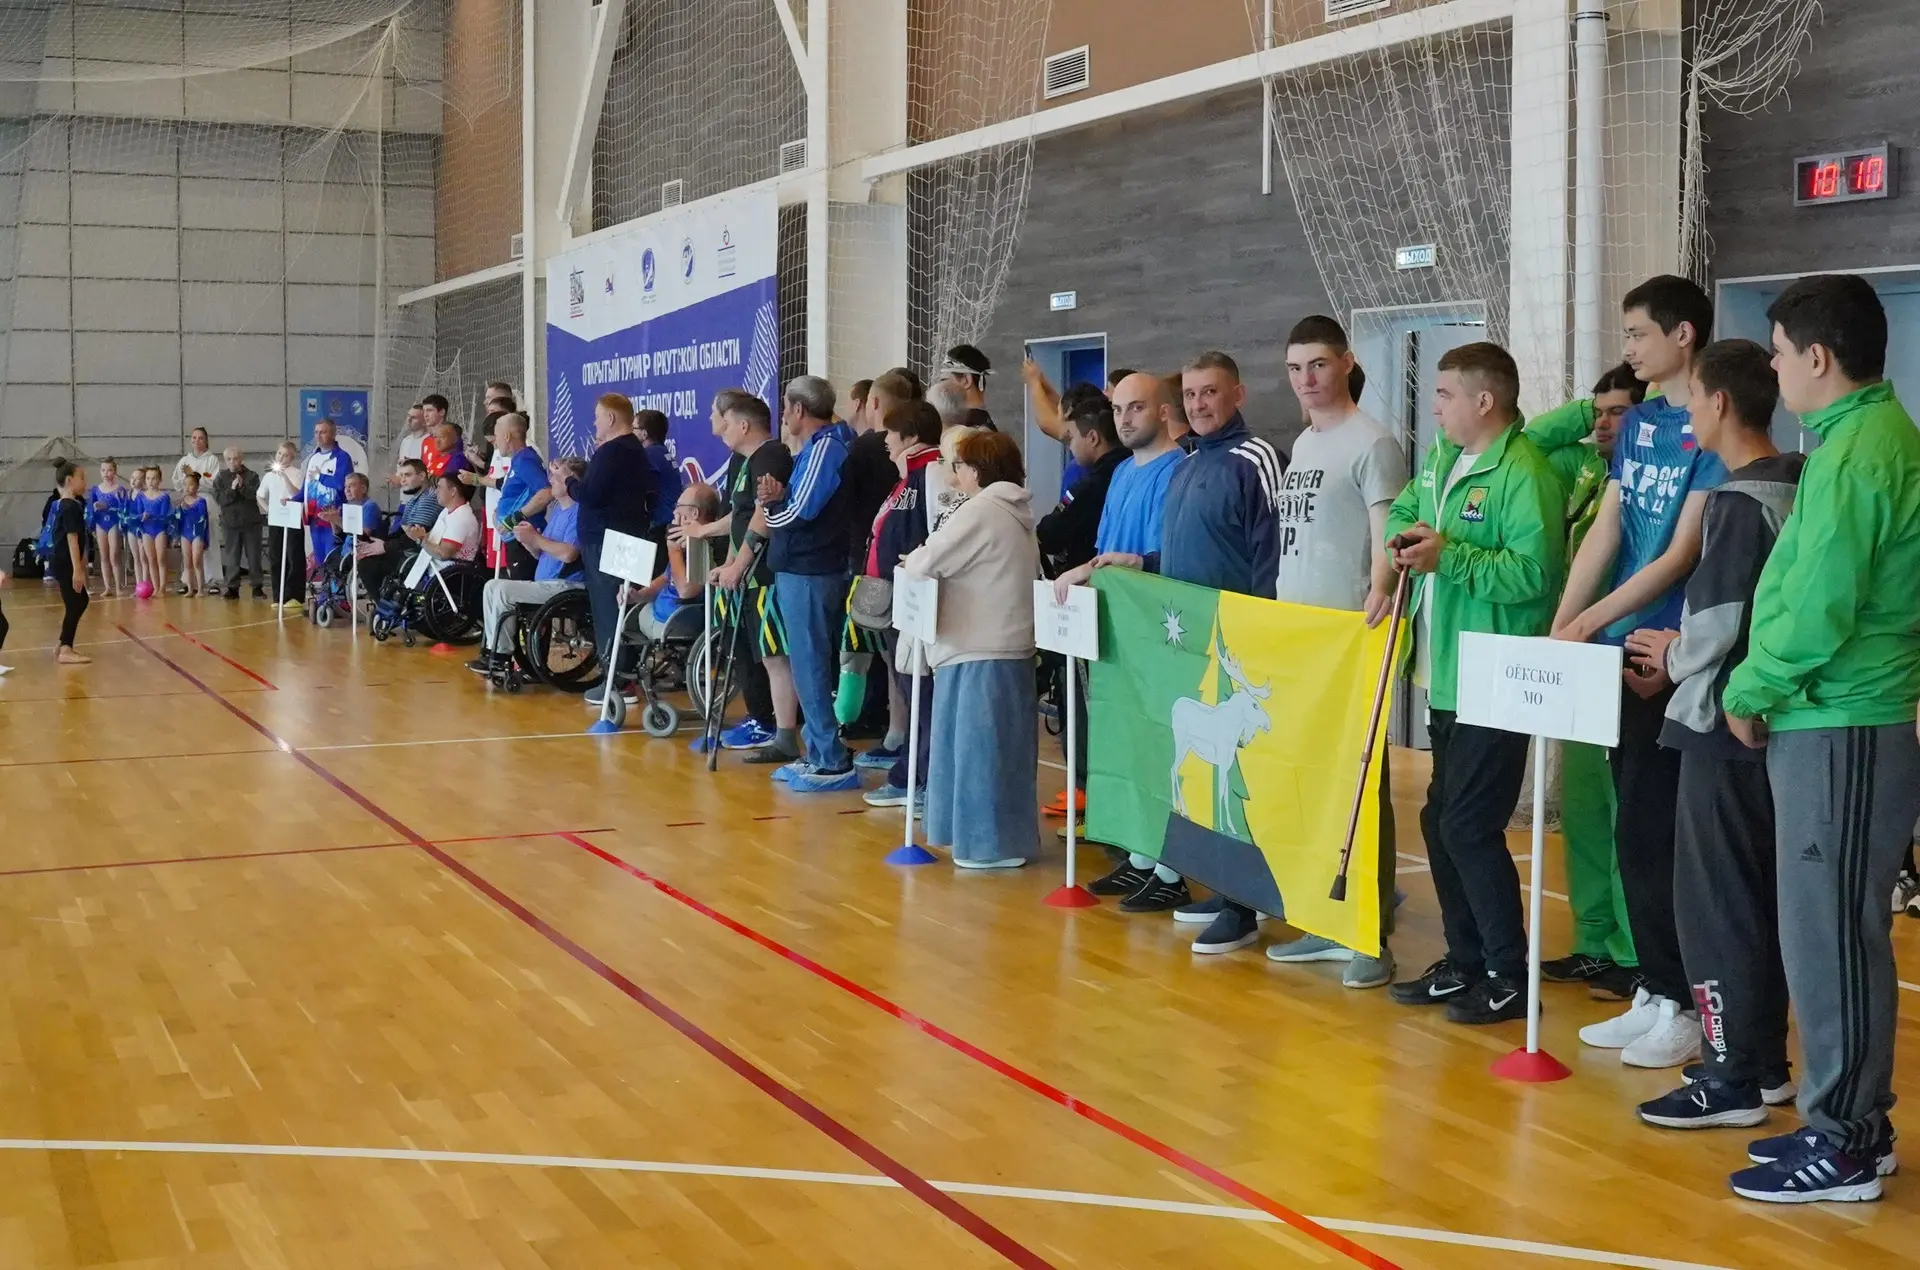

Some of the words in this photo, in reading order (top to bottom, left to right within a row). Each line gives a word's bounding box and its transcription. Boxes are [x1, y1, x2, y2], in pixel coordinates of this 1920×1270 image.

[582, 352, 620, 386] ОТКРЫТЫЙ
[620, 353, 651, 381] ТУРНИР
[700, 337, 740, 370] ОБЛАСТИ
[1505, 663, 1564, 686] ОЁКСКОЕ
[1522, 690, 1543, 706] МО
